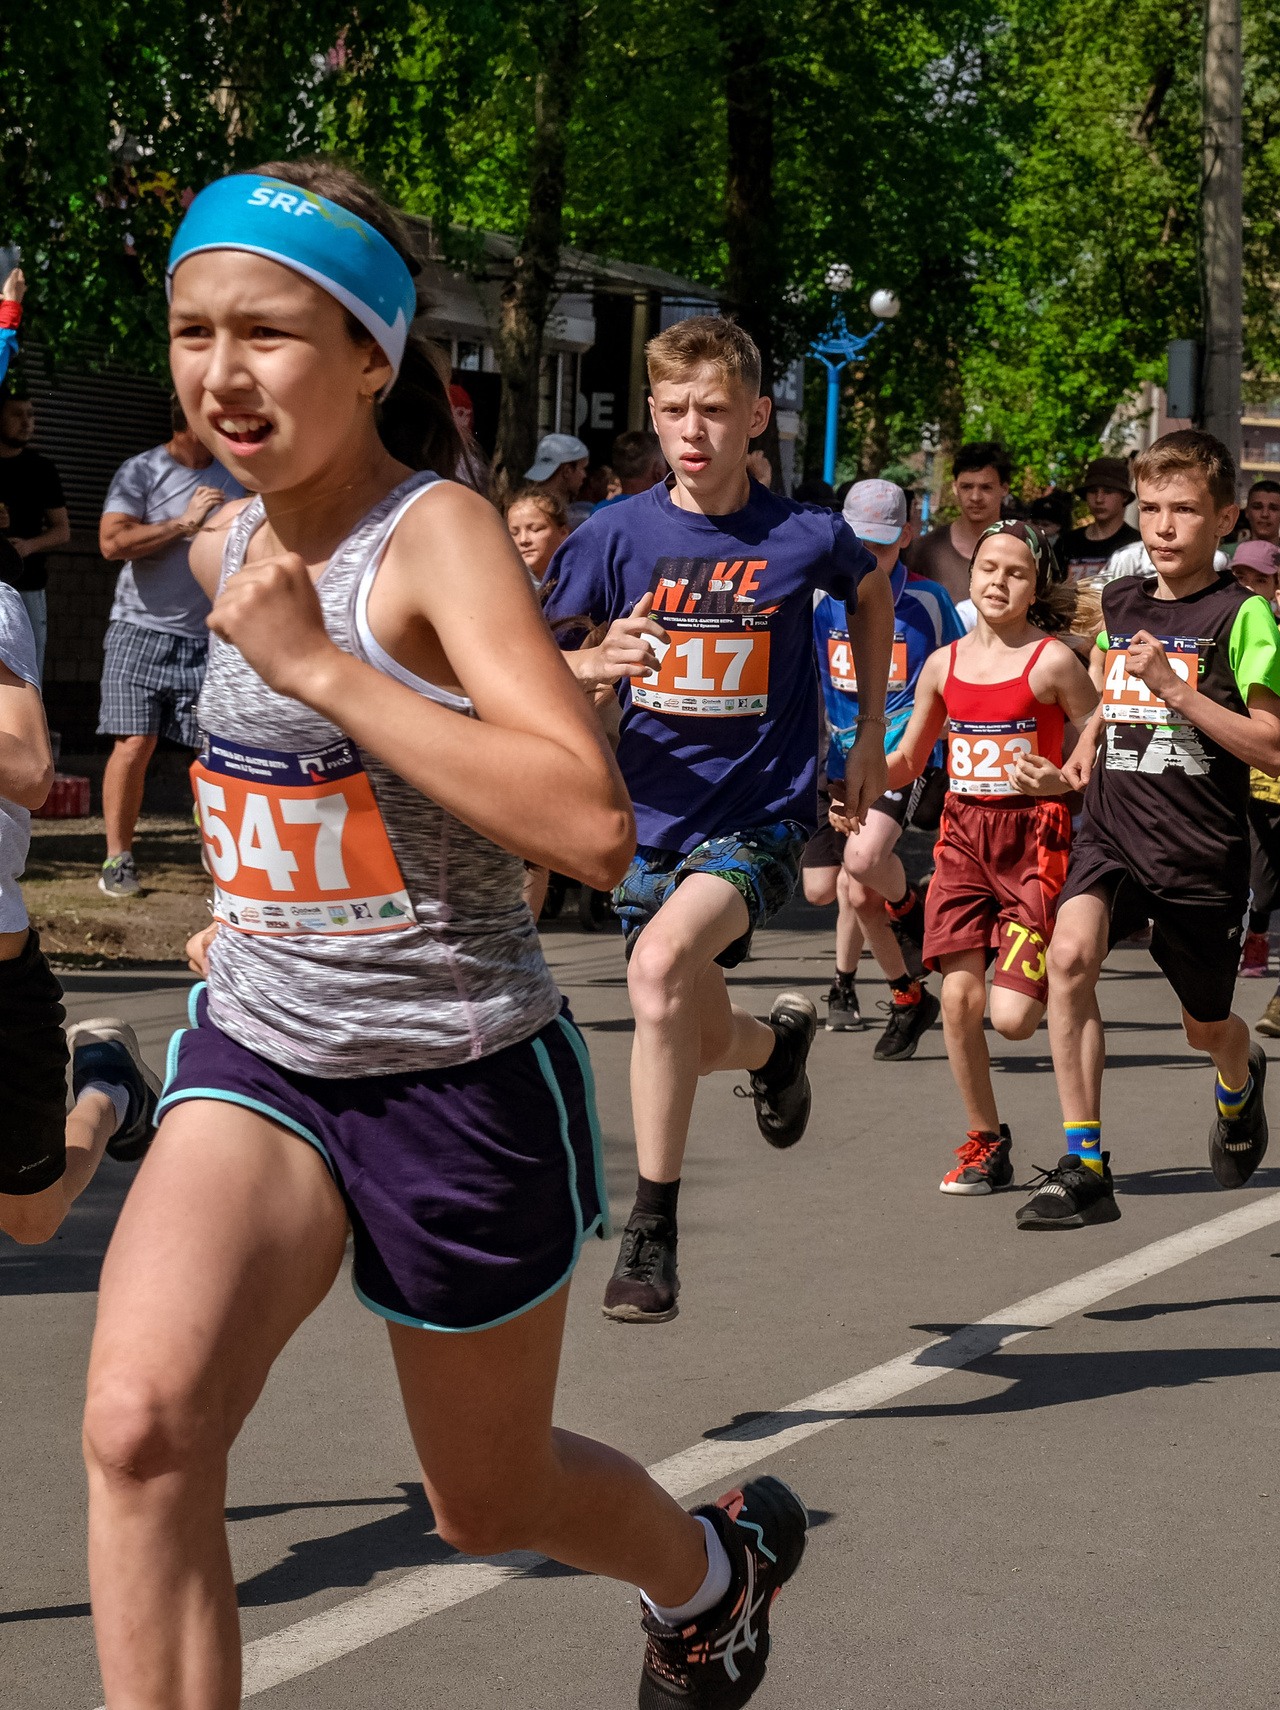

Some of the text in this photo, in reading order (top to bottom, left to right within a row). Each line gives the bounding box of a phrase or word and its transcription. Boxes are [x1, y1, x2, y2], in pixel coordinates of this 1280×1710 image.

[246, 187, 321, 217] SRF
[951, 737, 1032, 777] 823
[196, 777, 351, 892] 547
[1002, 921, 1047, 981] 73
